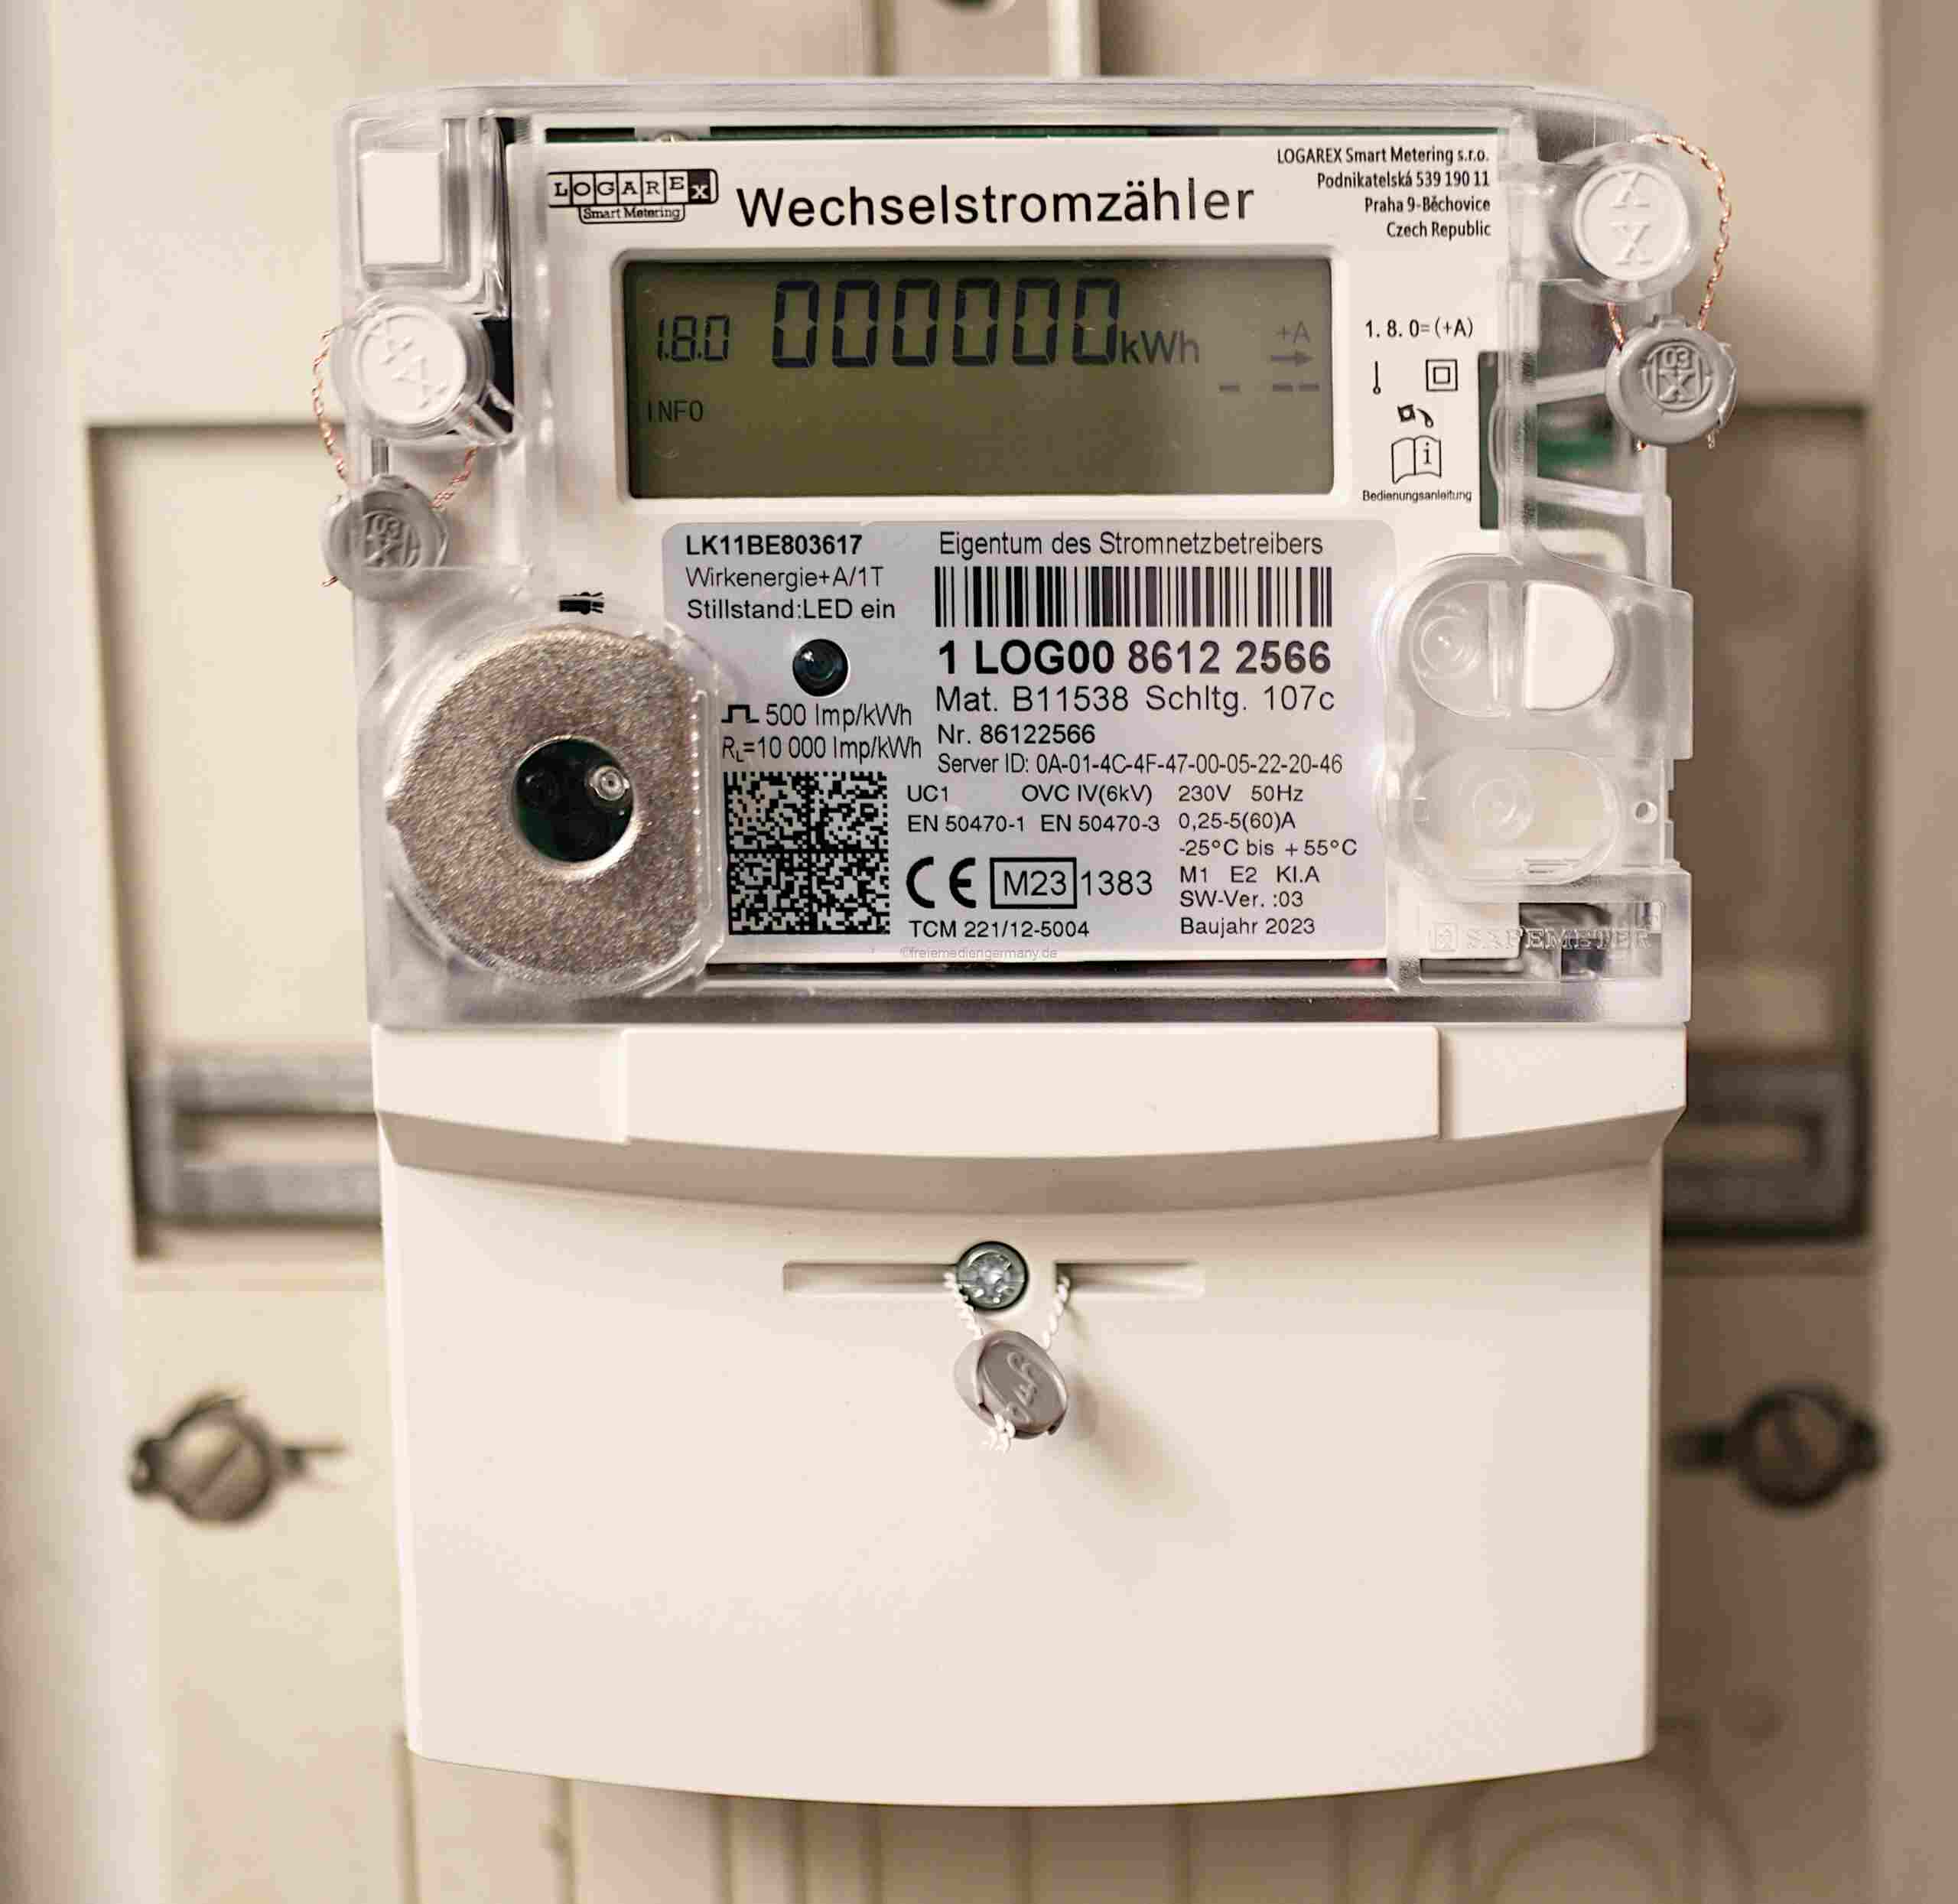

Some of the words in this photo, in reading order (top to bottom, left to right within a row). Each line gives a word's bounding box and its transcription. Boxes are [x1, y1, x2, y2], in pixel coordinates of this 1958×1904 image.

[1278, 148, 1342, 164] LOGAREX
[1346, 148, 1386, 162] Smart
[1391, 147, 1453, 165] Metering
[1458, 149, 1490, 163] s.r.o.
[554, 177, 710, 200] LOGAREX
[1318, 171, 1412, 187] Podnikatelská
[1417, 171, 1441, 187] 539
[1446, 171, 1469, 186] 190
[1475, 171, 1488, 186] 11
[737, 177, 1254, 227] Wechselstromzähler
[1365, 197, 1403, 212] Praha
[584, 207, 620, 220] Smart
[623, 206, 681, 221] Metering
[1387, 221, 1427, 237] Czech
[1432, 220, 1490, 240] Republic
[772, 278, 1120, 368] 000000
[1121, 329, 1200, 366] kWh
[1277, 321, 1309, 343] +A
[647, 400, 704, 422] INFO
[1363, 490, 1472, 503] Bedienungsanleitung
[687, 535, 862, 555] LK11BE803617
[940, 532, 1043, 561] Eigentum
[1052, 532, 1091, 554] des
[1100, 531, 1322, 554] Stromnetzbetreibers
[688, 599, 852, 619] Stillstand:LED
[861, 599, 895, 618] ein
[939, 640, 955, 674] 1
[976, 640, 1114, 675] LOG00
[1129, 640, 1219, 673] 8612
[1236, 640, 1330, 673] 2566
[937, 686, 997, 711] Mat.
[1014, 686, 1128, 711] B11538
[1147, 685, 1246, 717] Schltg.
[1264, 685, 1334, 710] 107c
[766, 704, 806, 726] 500
[816, 704, 911, 731] Imp/kWh
[938, 724, 971, 744] Nr.
[981, 724, 1094, 744] 86122566
[789, 736, 825, 759] 000
[834, 737, 922, 763] Imp/kWh
[938, 753, 999, 773] Server
[1006, 753, 1028, 773] ID:
[1036, 753, 1342, 773] 0A-01-4C-4F-47-00-05-22-20-46
[908, 785, 947, 802] UC1
[1022, 784, 1069, 802] OVC
[1078, 785, 1152, 806] IV(6kV)
[1179, 785, 1231, 802] 230V
[1251, 785, 1303, 802] 50Hz
[909, 815, 938, 832] EN
[946, 815, 1023, 832] 50470-1
[1041, 815, 1071, 832] EN
[1078, 815, 1160, 832] 50470-3
[1179, 812, 1295, 832] 0,25-5(60)A
[1179, 839, 1238, 856] -25°C
[1247, 839, 1273, 855] bis
[1004, 871, 1066, 896] M23
[1081, 871, 1152, 896] 1383
[1181, 866, 1206, 883] M1
[1231, 866, 1257, 883] E2
[1180, 890, 1264, 907] SW-Ver.
[909, 920, 956, 937] TCM
[964, 921, 1089, 937] 221/12-5004
[1181, 917, 1257, 938] Baujahr
[1267, 918, 1315, 934] 2023
